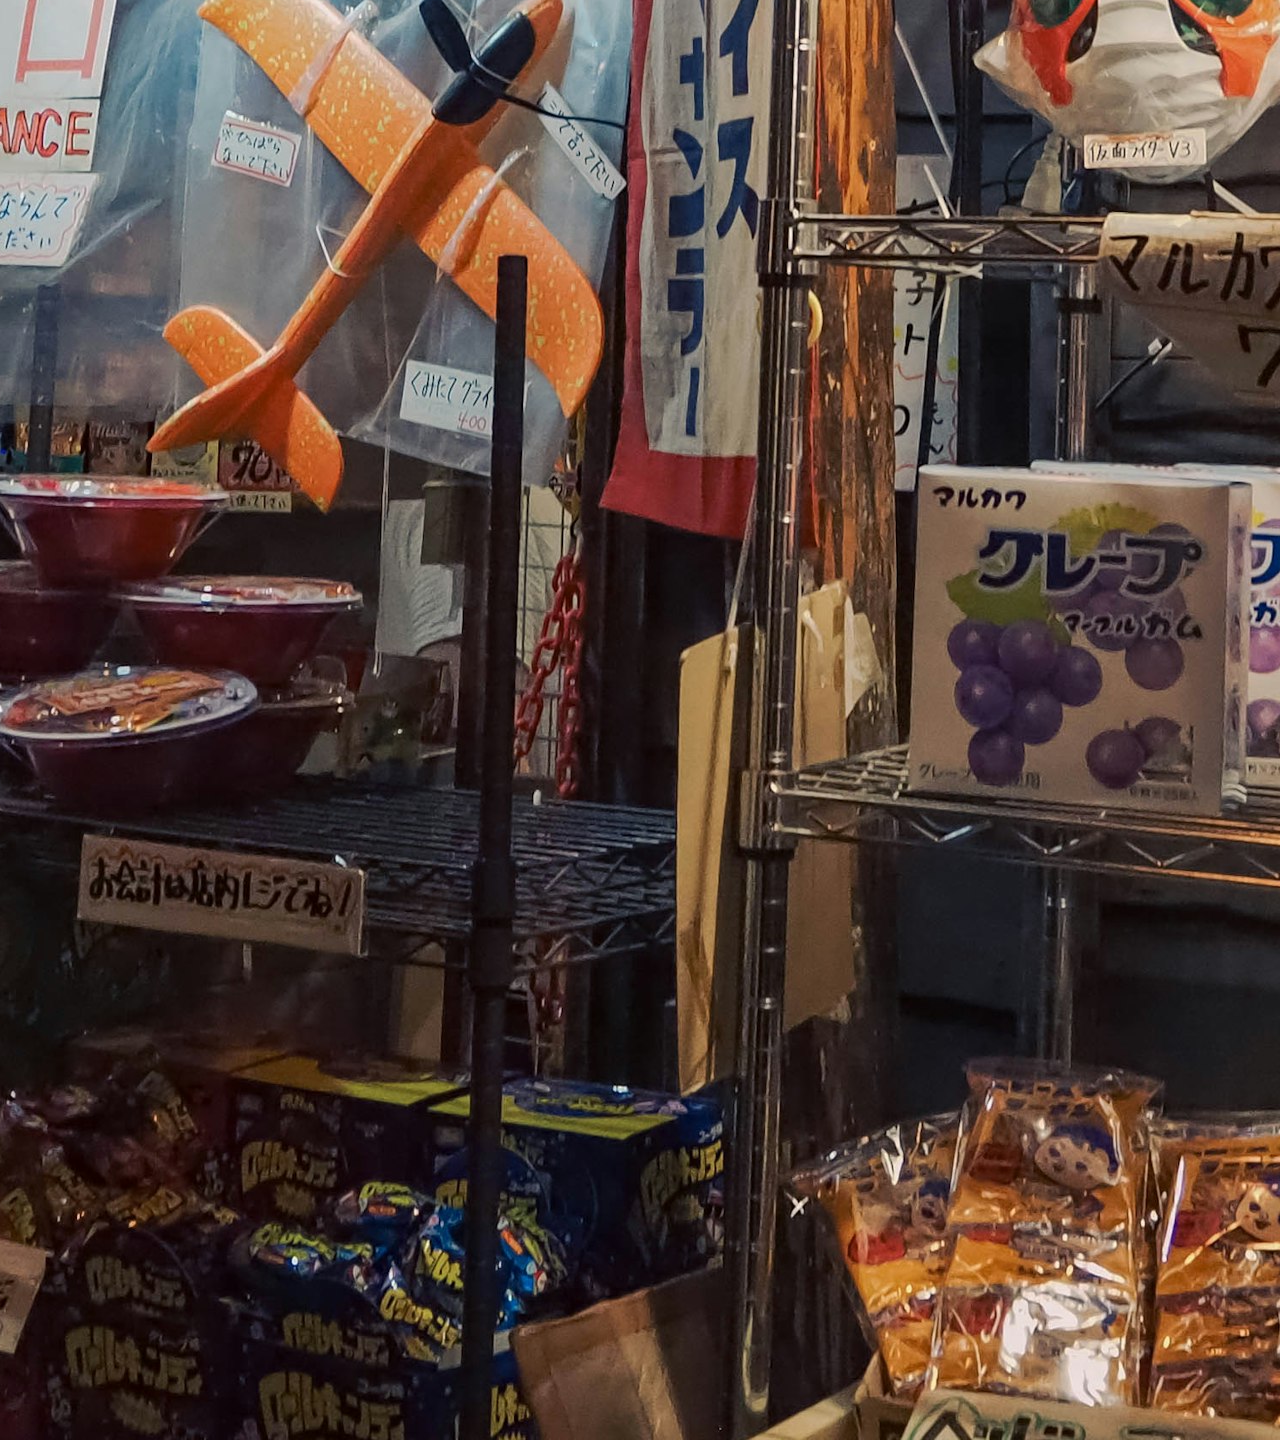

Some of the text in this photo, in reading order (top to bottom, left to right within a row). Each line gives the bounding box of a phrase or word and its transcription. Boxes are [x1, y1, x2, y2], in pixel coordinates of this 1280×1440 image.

[931, 485, 1028, 512] マルカワ
[977, 526, 1205, 598] グレープ
